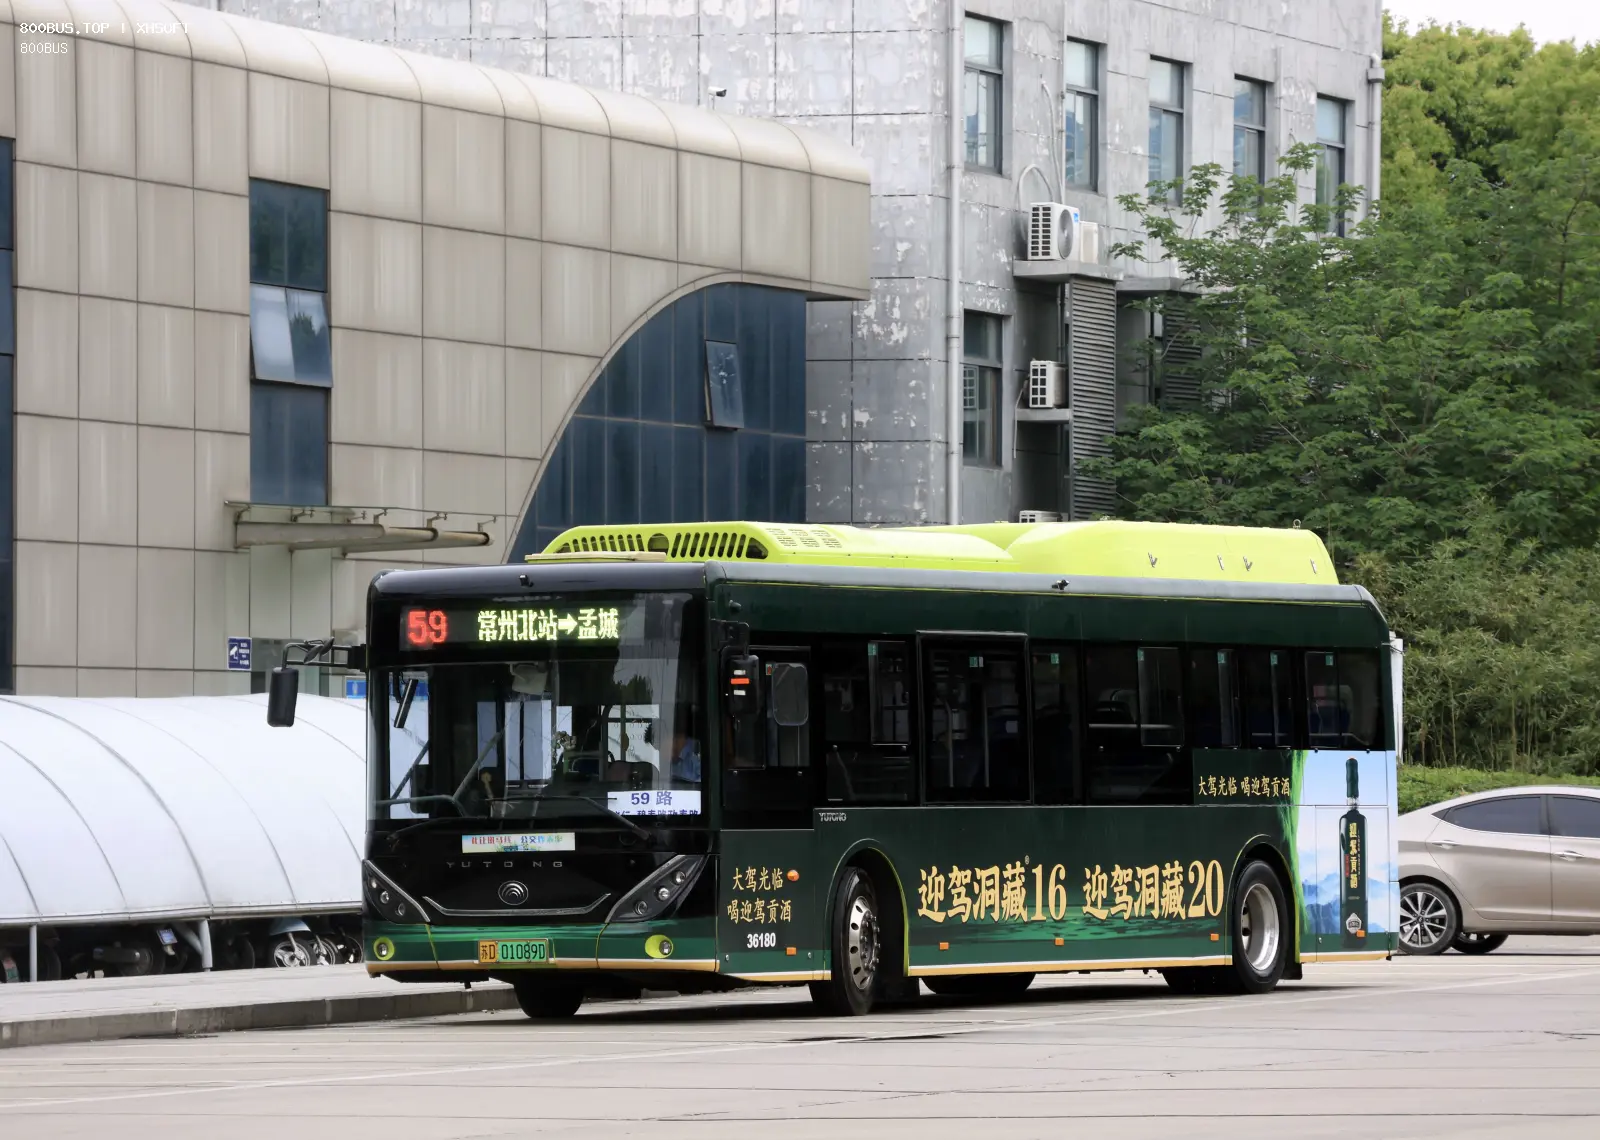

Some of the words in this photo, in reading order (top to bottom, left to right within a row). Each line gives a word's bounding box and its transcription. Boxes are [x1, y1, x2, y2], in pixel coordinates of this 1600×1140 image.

[408, 611, 448, 643] 59
[477, 609, 557, 641] 常州北站
[577, 608, 619, 640] 孟城
[1198, 776, 1237, 797] 大驾光临
[1241, 776, 1290, 797] 喝迎驾贡酒
[631, 792, 650, 805] 59
[656, 791, 672, 806] 路
[820, 813, 847, 821] YUTONG
[732, 867, 784, 891] 大驾光临
[727, 898, 792, 924] 喝迎驾贡酒
[747, 932, 776, 948] 36180
